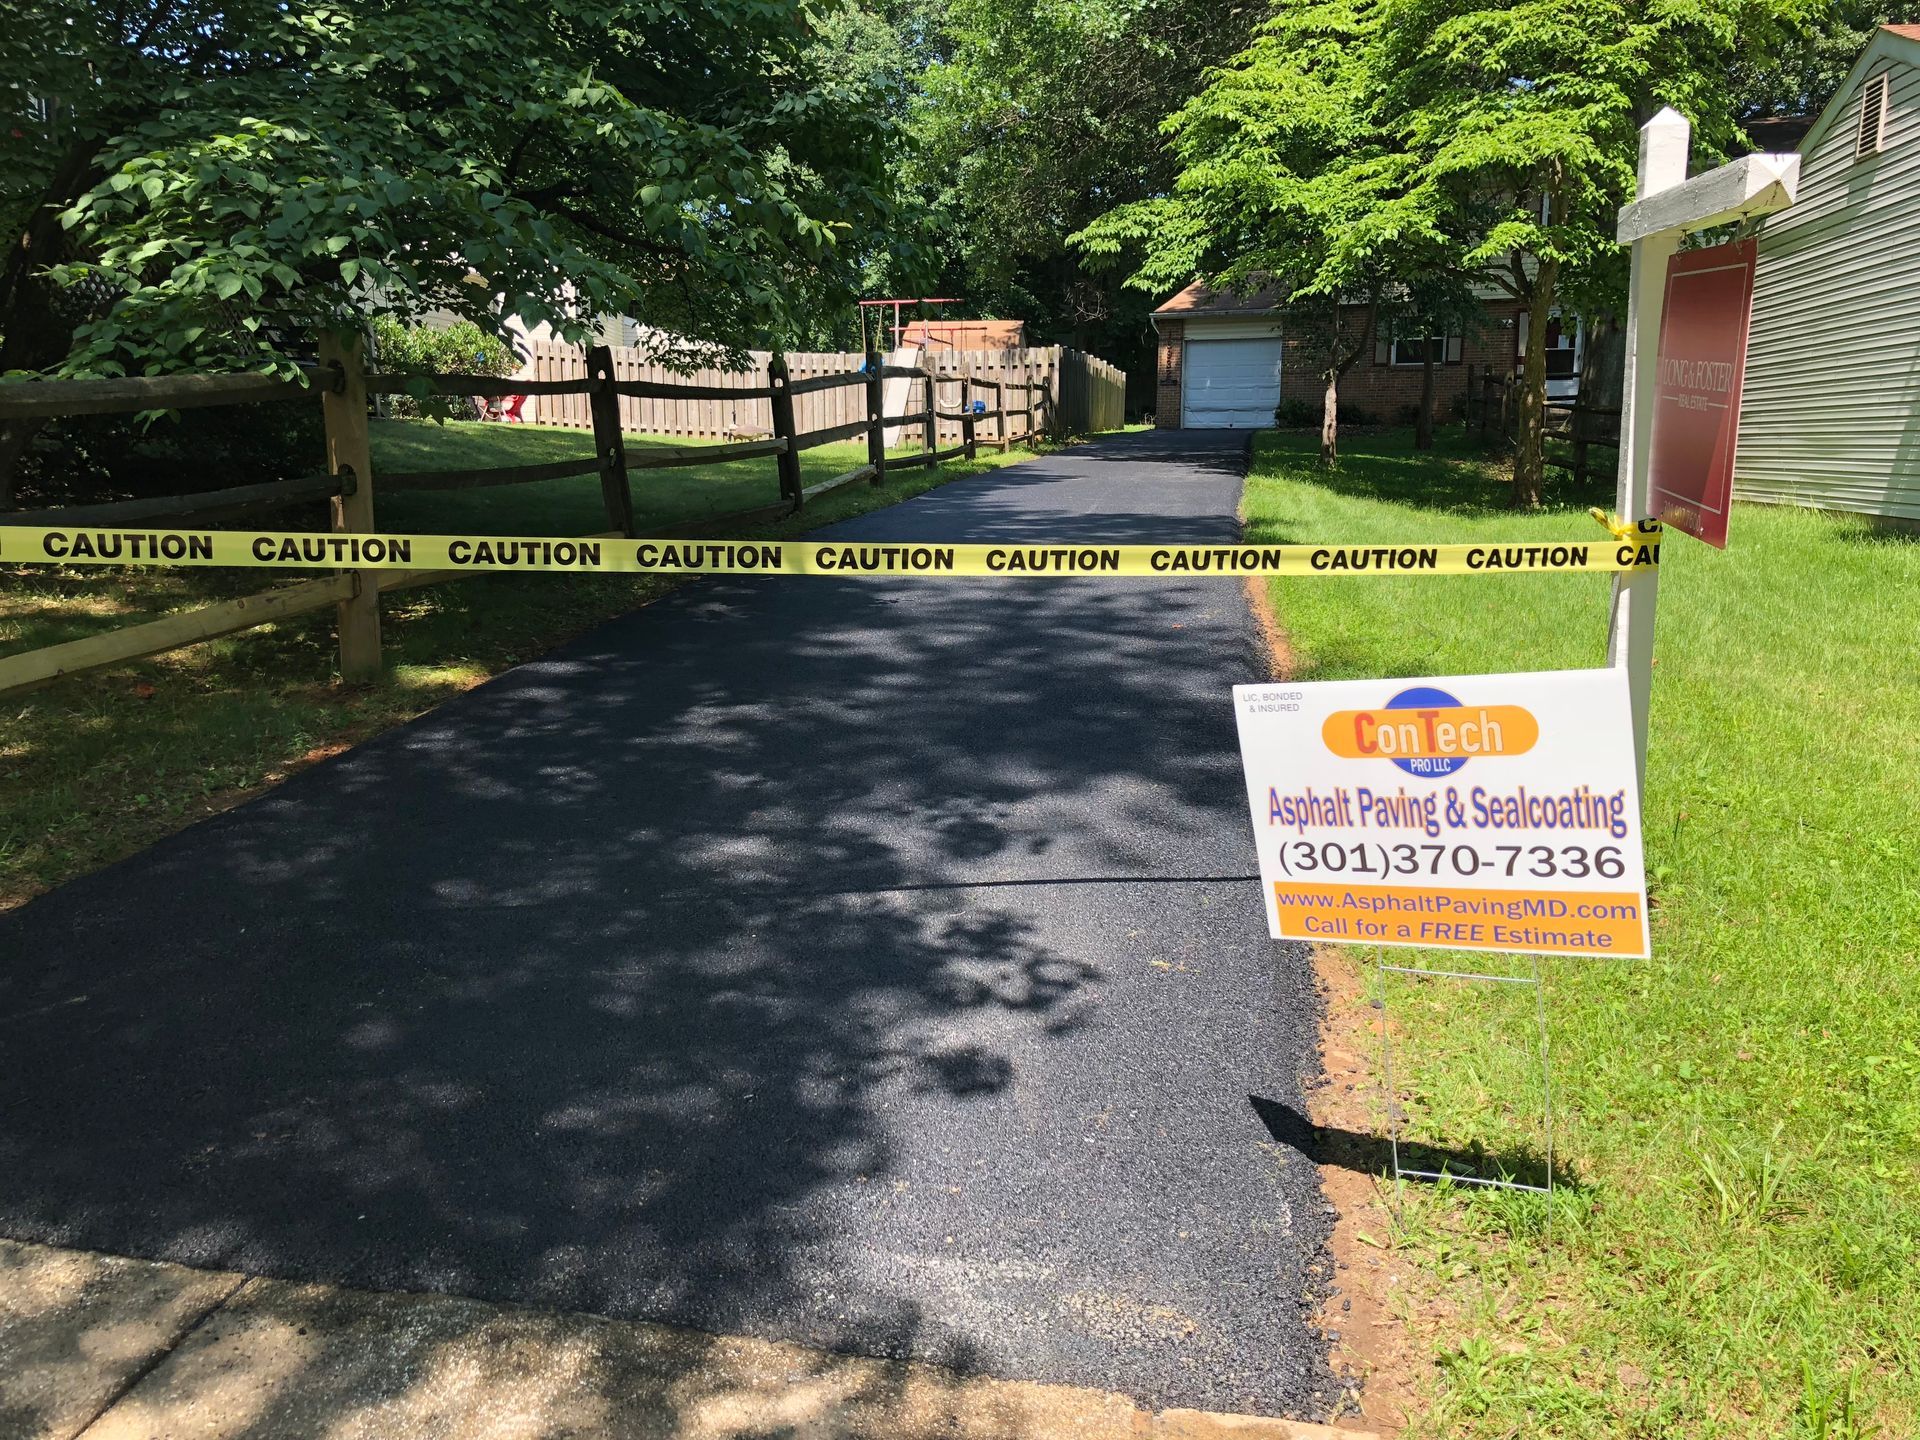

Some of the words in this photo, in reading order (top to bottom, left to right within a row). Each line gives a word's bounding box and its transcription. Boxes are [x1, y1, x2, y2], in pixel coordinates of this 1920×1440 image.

[1663, 359, 1688, 387] LONG
[1695, 361, 1733, 393] FOSTER
[43, 532, 213, 560] CAUTION
[252, 536, 411, 563] CAUTION
[448, 540, 601, 566] CAUTION
[636, 544, 782, 569] CAUTION
[816, 547, 955, 570] CAUTION
[986, 549, 1120, 571] CAUTION
[1150, 549, 1281, 571] CAUTION
[1310, 548, 1437, 569] CAUTION
[1466, 546, 1588, 569] CAUTION
[1249, 705, 1256, 713] &
[1257, 703, 1300, 713] INSURED
[1262, 692, 1303, 701] BONDED
[1354, 709, 1504, 755] ConTech
[1410, 758, 1431, 773] PRO
[1433, 758, 1451, 772] LLC
[1269, 786, 1354, 835] Asphalt
[1356, 786, 1441, 838] Paving
[1446, 786, 1467, 829] &
[1471, 785, 1628, 839] Sealcoating
[1279, 841, 1626, 880] (301)370-7336
[1278, 891, 1638, 920] www.AsphaltPavingMD.com
[1304, 916, 1347, 935] Call
[1354, 919, 1388, 937] for
[1397, 923, 1411, 938] a
[1419, 921, 1485, 942] FREE
[1493, 925, 1614, 948] Estimate
